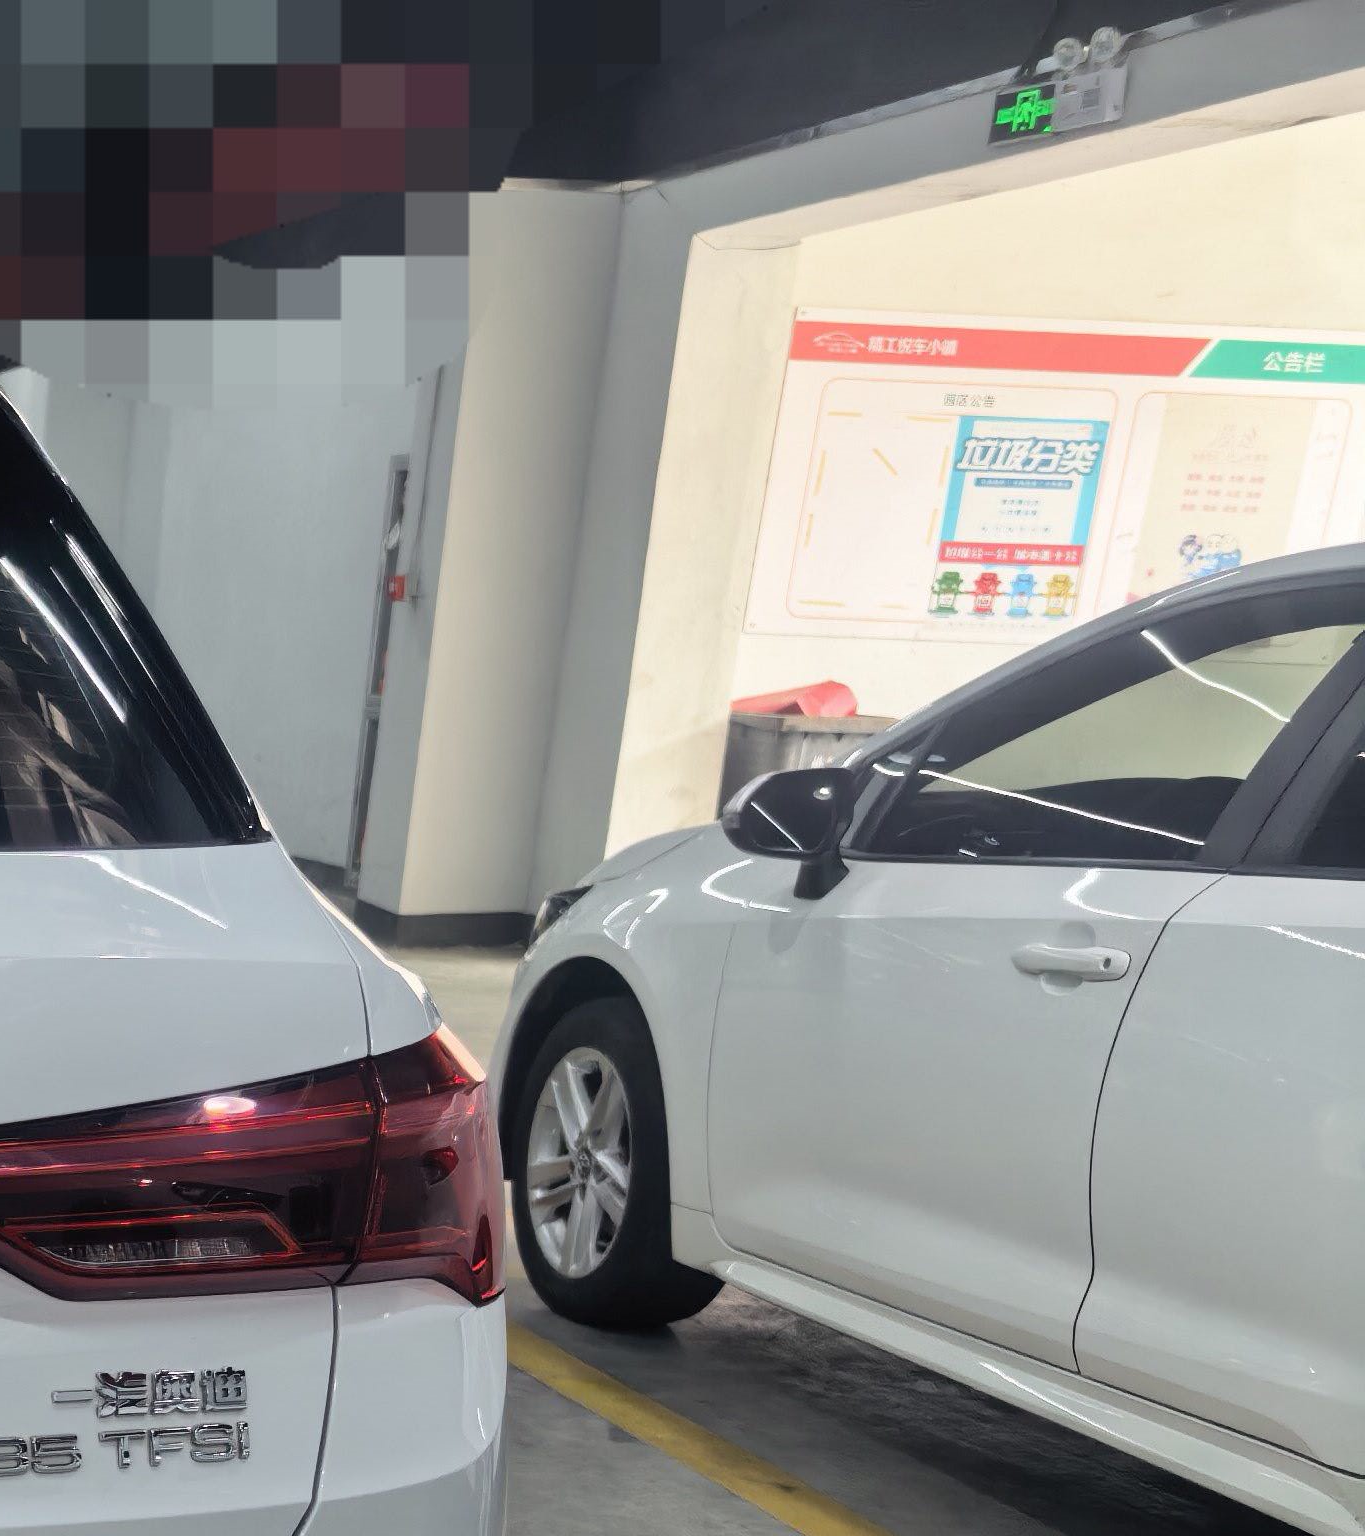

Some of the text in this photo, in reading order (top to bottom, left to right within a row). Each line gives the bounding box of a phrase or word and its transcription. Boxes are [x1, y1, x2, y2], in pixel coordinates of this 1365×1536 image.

[1262, 351, 1326, 373] 公告栏
[955, 437, 1101, 474] 垃圾分类
[50, 1367, 248, 1418] 一汽奥迪
[97, 1421, 252, 1469] TFSI
